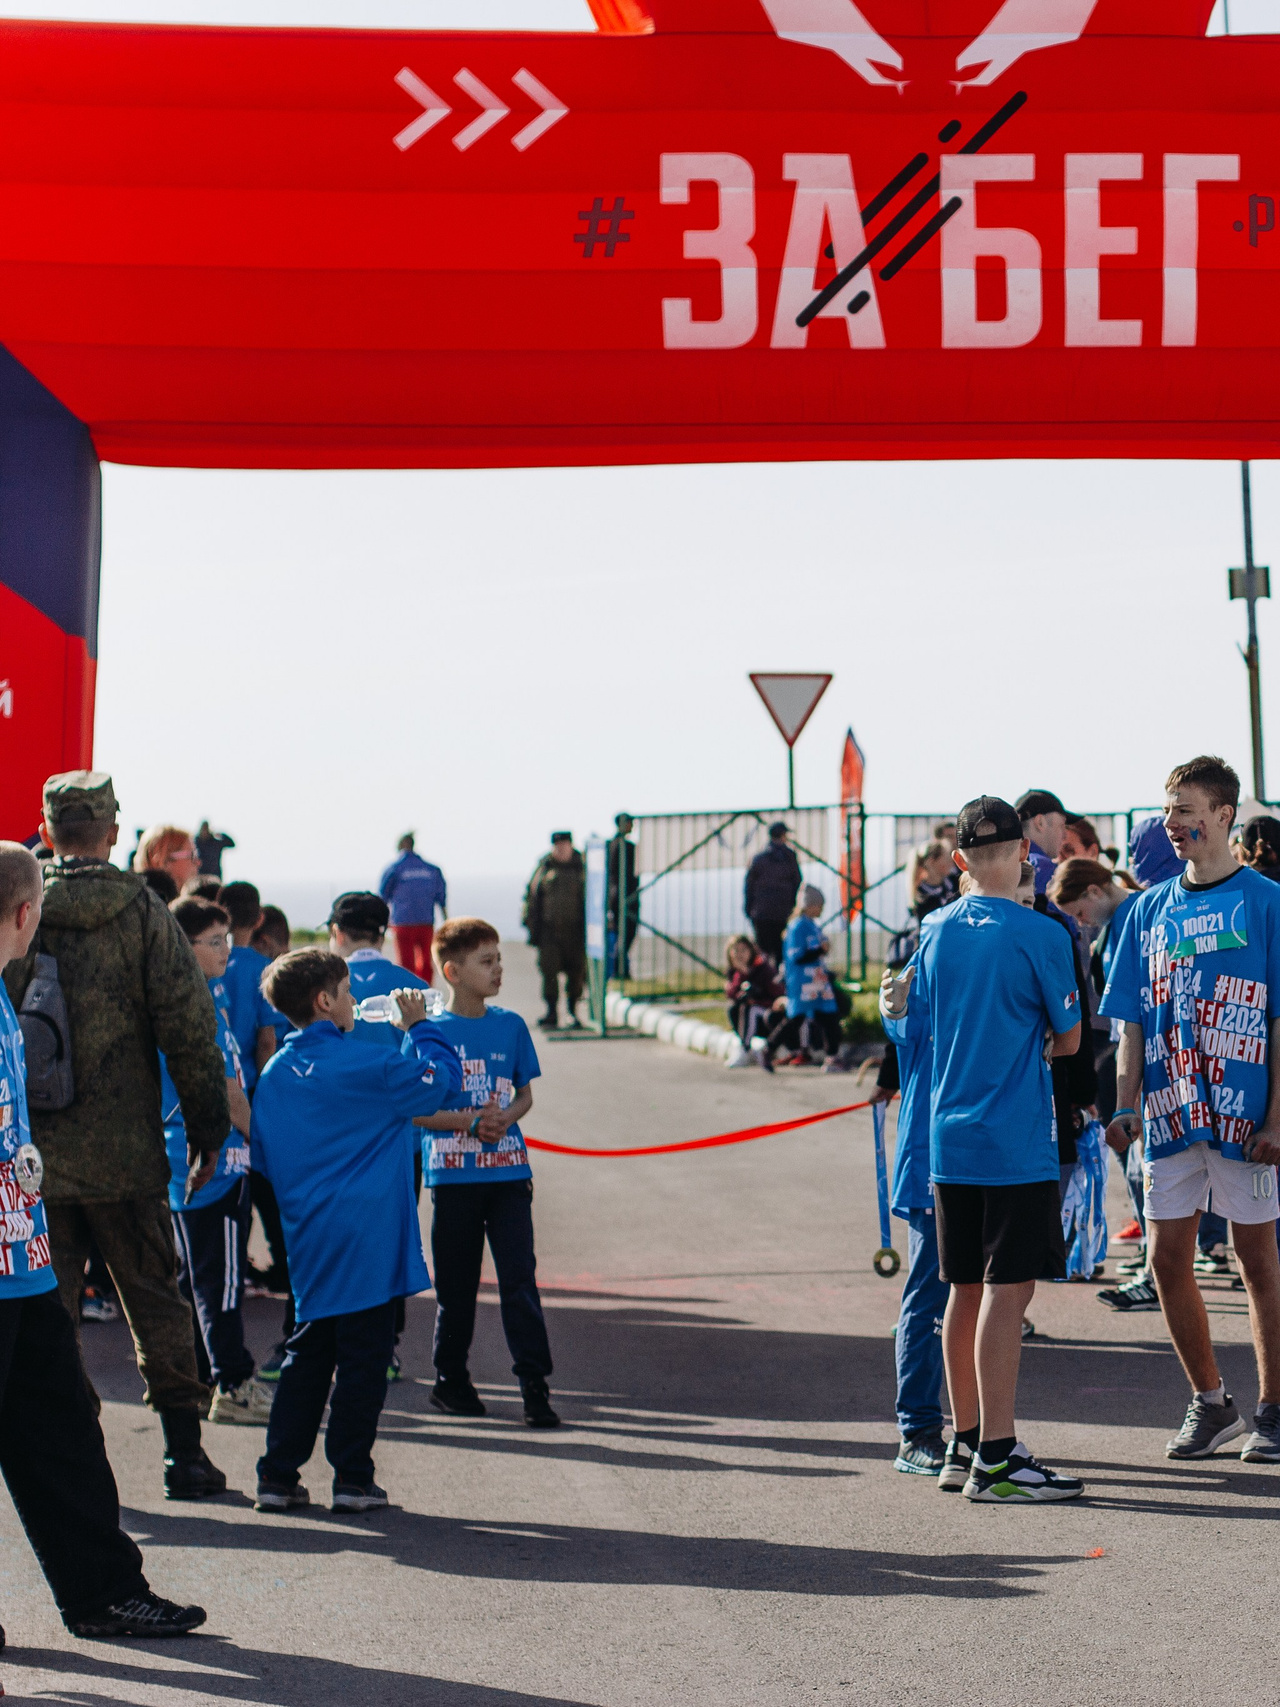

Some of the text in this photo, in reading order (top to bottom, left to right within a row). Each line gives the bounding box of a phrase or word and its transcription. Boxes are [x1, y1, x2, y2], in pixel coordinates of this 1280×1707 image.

[1182, 912, 1224, 938] 10021
[1210, 1084, 1245, 1117] 024
[1252, 1170, 1272, 1199] 10
